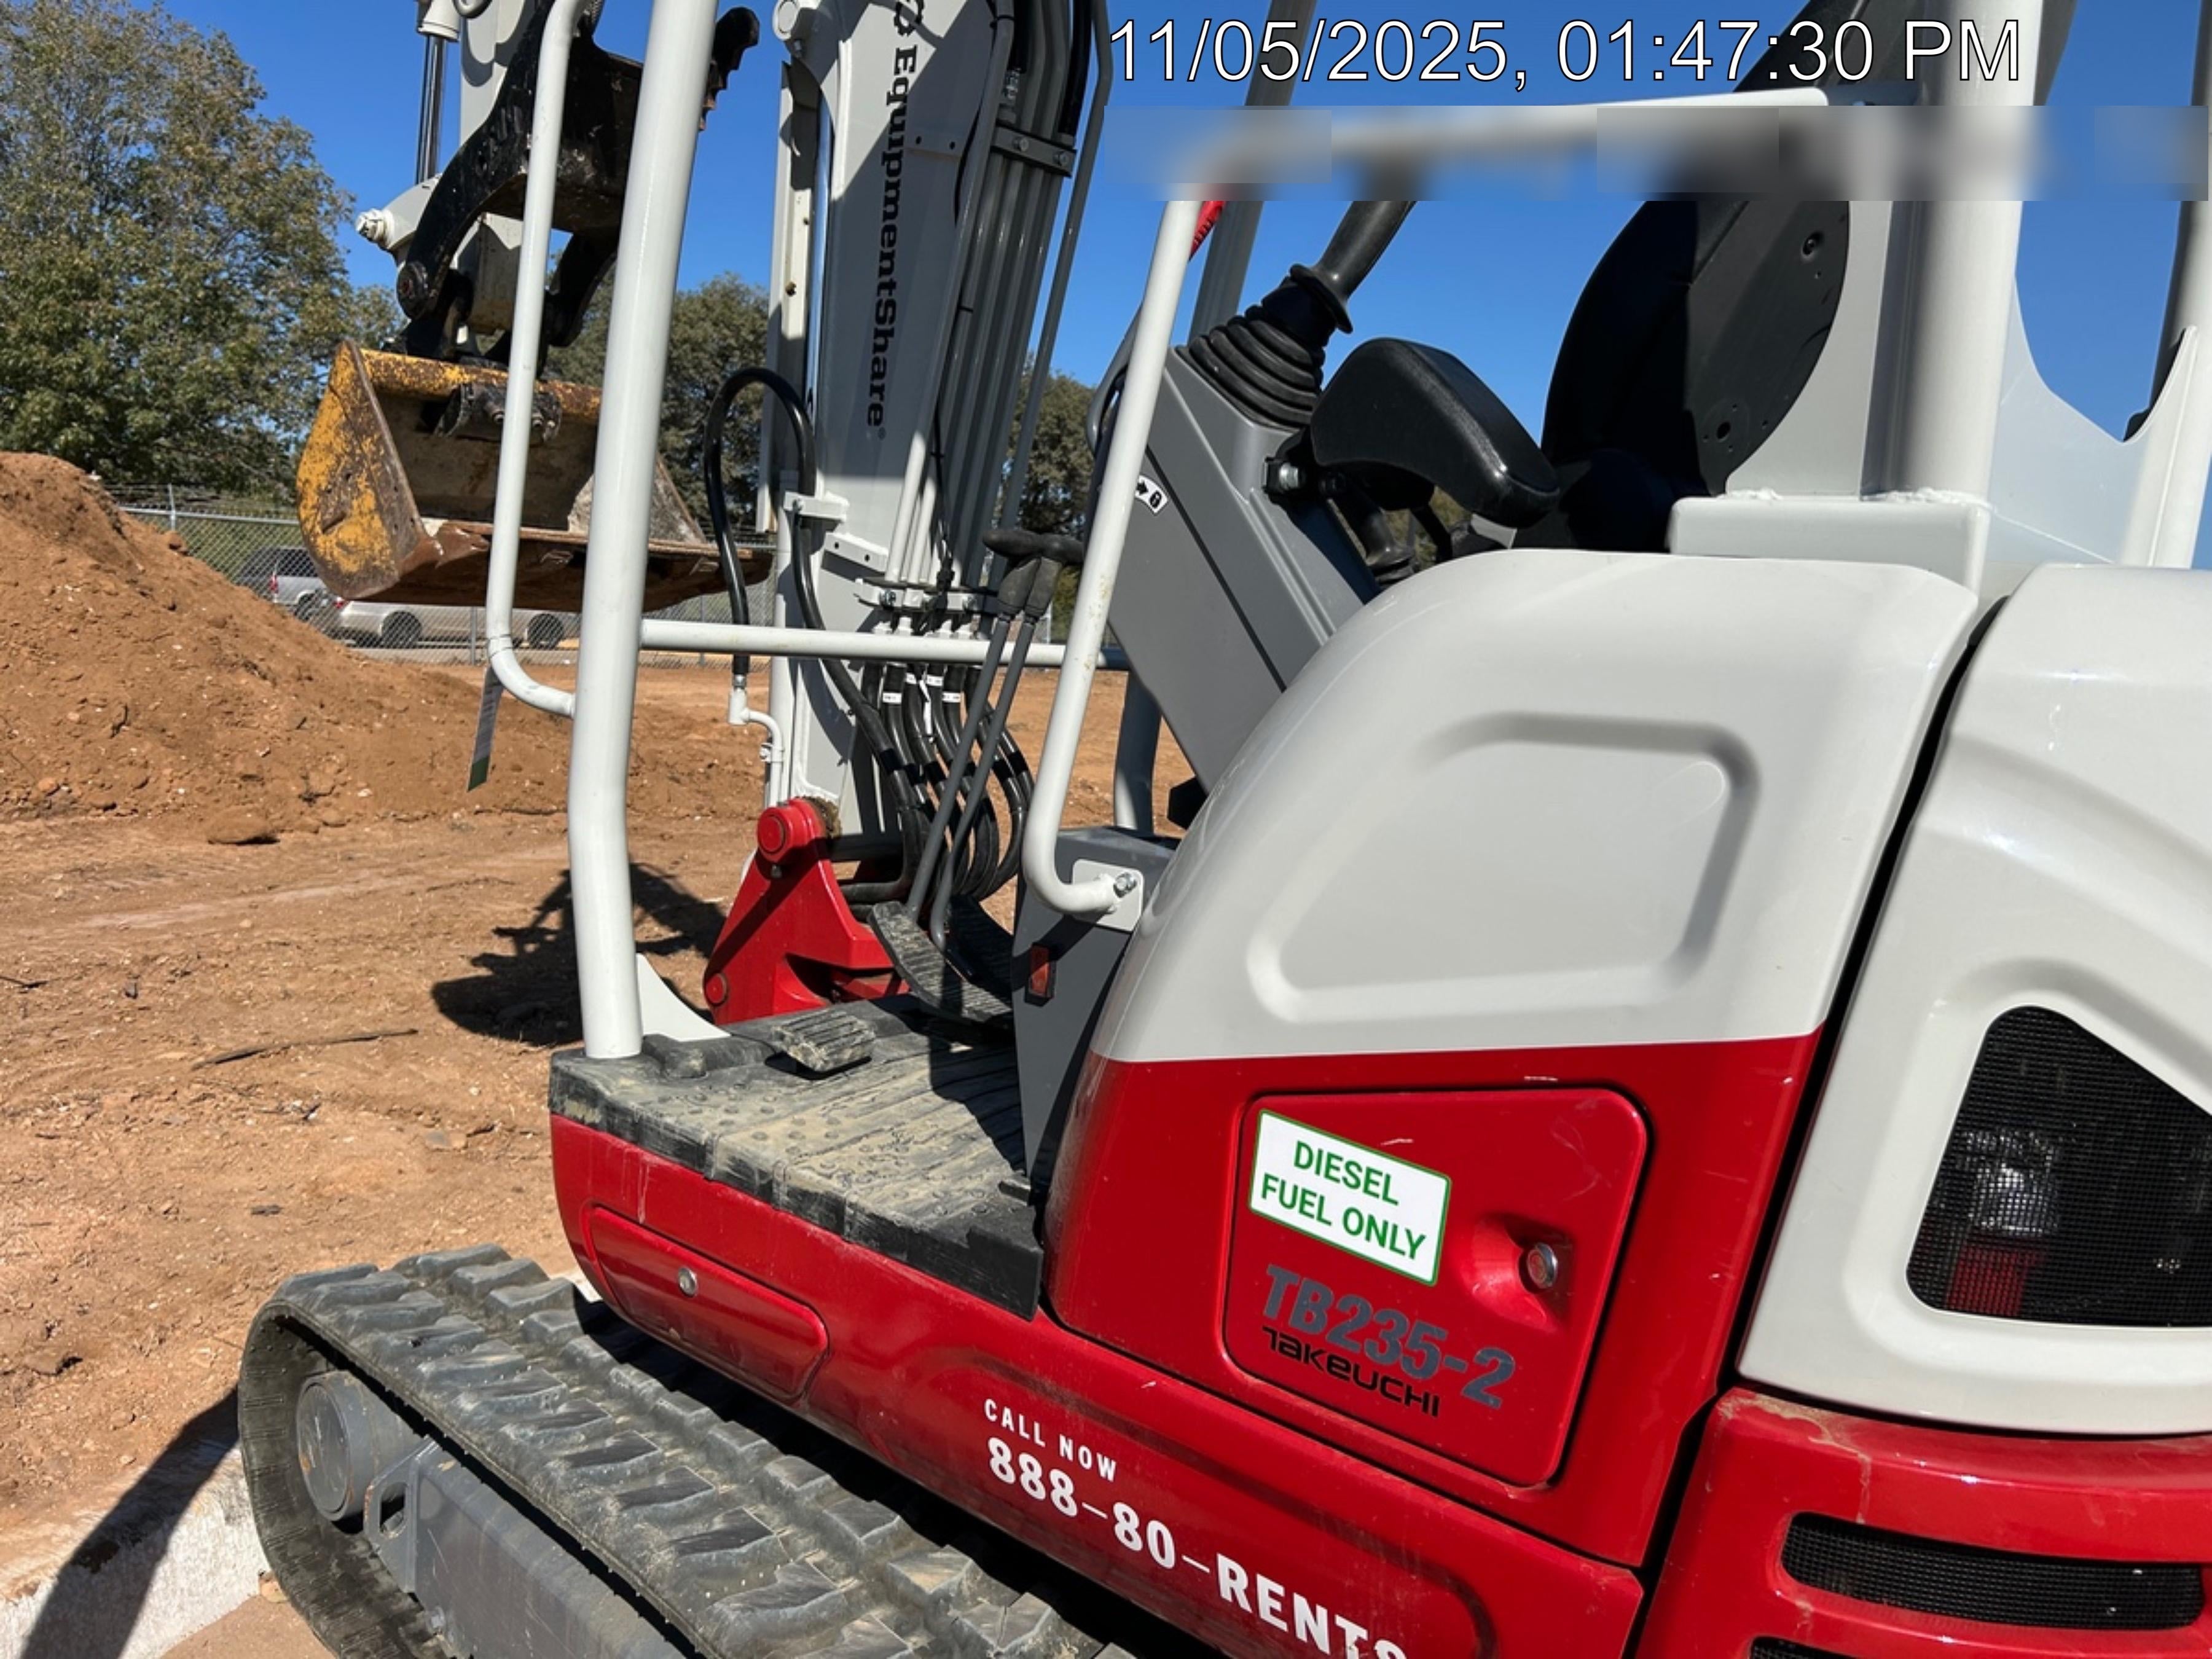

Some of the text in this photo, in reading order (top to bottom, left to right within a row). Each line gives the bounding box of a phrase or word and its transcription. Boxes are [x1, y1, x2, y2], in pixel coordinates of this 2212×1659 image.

[867, 45, 917, 427] EquipmentShare
[1260, 1172, 1427, 1261] FUEL ONLY
[1293, 1140, 1400, 1206] DIESEL
[1264, 1264, 1516, 1410] TB235-2
[984, 1398, 1117, 1482] CALL NOW
